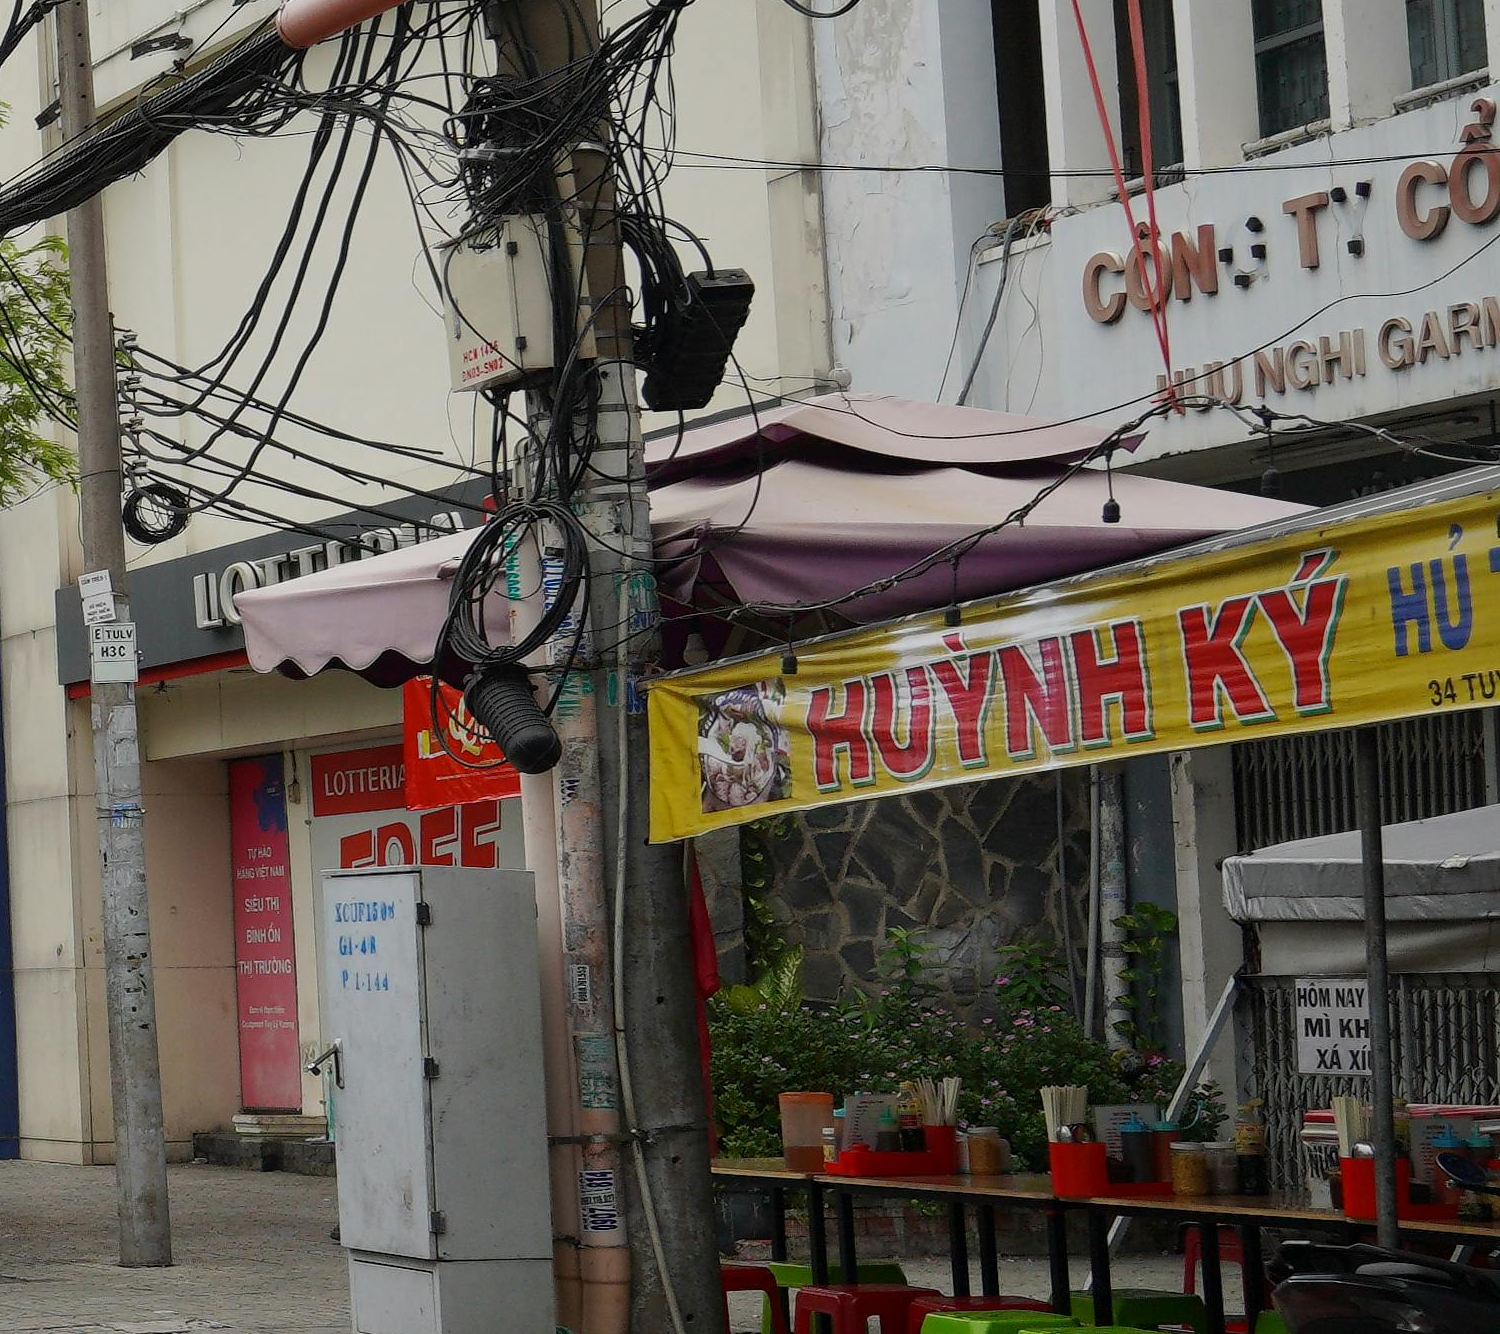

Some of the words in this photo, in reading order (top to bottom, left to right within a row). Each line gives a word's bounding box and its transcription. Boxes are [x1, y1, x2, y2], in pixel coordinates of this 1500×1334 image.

[1253, 328, 1366, 397] NGHI
[95, 629, 102, 640] E
[105, 629, 133, 640] TULV
[101, 646, 126, 657] H3C
[805, 631, 1156, 794] HUỲNH
[1177, 547, 1348, 732] KÝ
[1387, 523, 1473, 656] HỦ
[1428, 677, 1457, 706] 34
[244, 894, 264, 913] SIÊU
[265, 896, 280, 915] THỊ
[238, 959, 253, 979] THỊ
[253, 957, 292, 975] TRƯỜNG
[1297, 982, 1331, 1007] HÔM
[1335, 987, 1365, 1008] NAY
[1304, 1013, 1331, 1037] MÌ
[1316, 1043, 1342, 1069] XÁ
